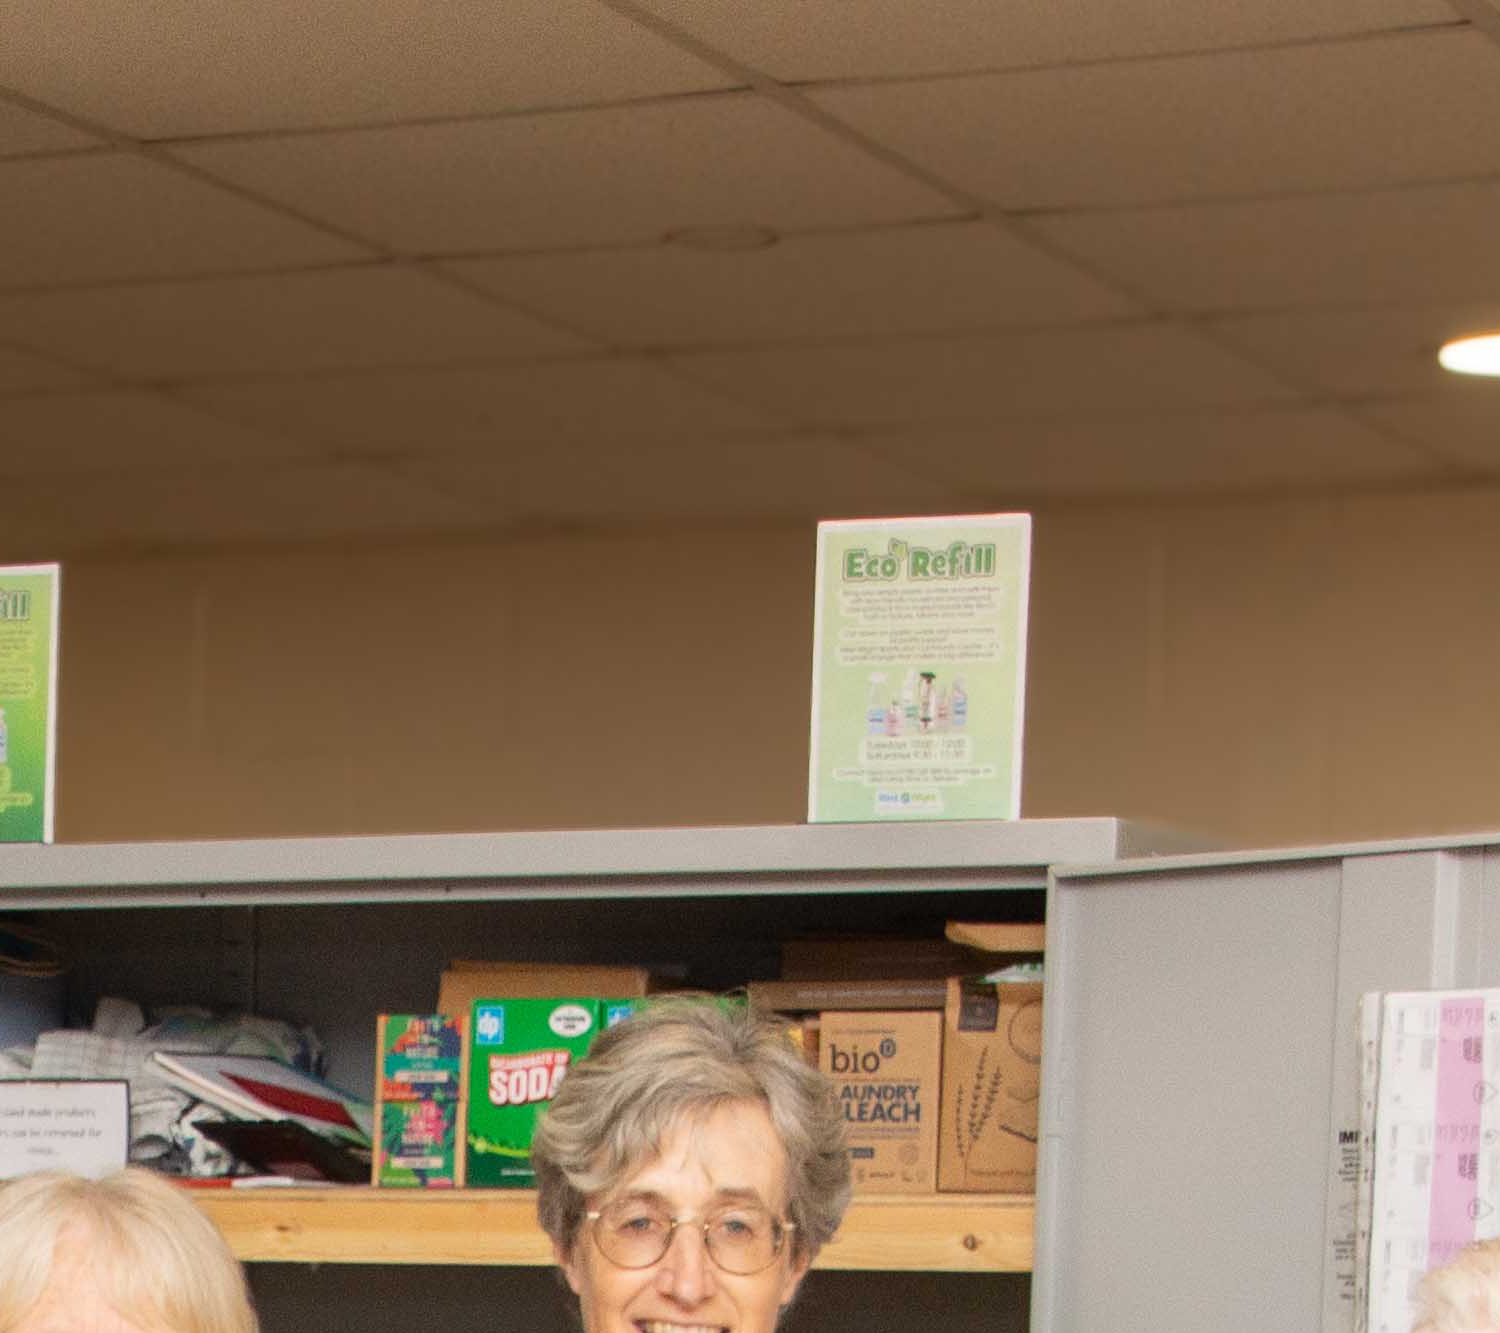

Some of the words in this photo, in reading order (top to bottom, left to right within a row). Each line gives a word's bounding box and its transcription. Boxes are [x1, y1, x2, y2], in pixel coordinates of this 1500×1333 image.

[842, 547, 901, 581] Eco
[908, 541, 996, 580] Refill
[838, 1085, 919, 1100] AUNDRY
[844, 1103, 920, 1122] LEACH
